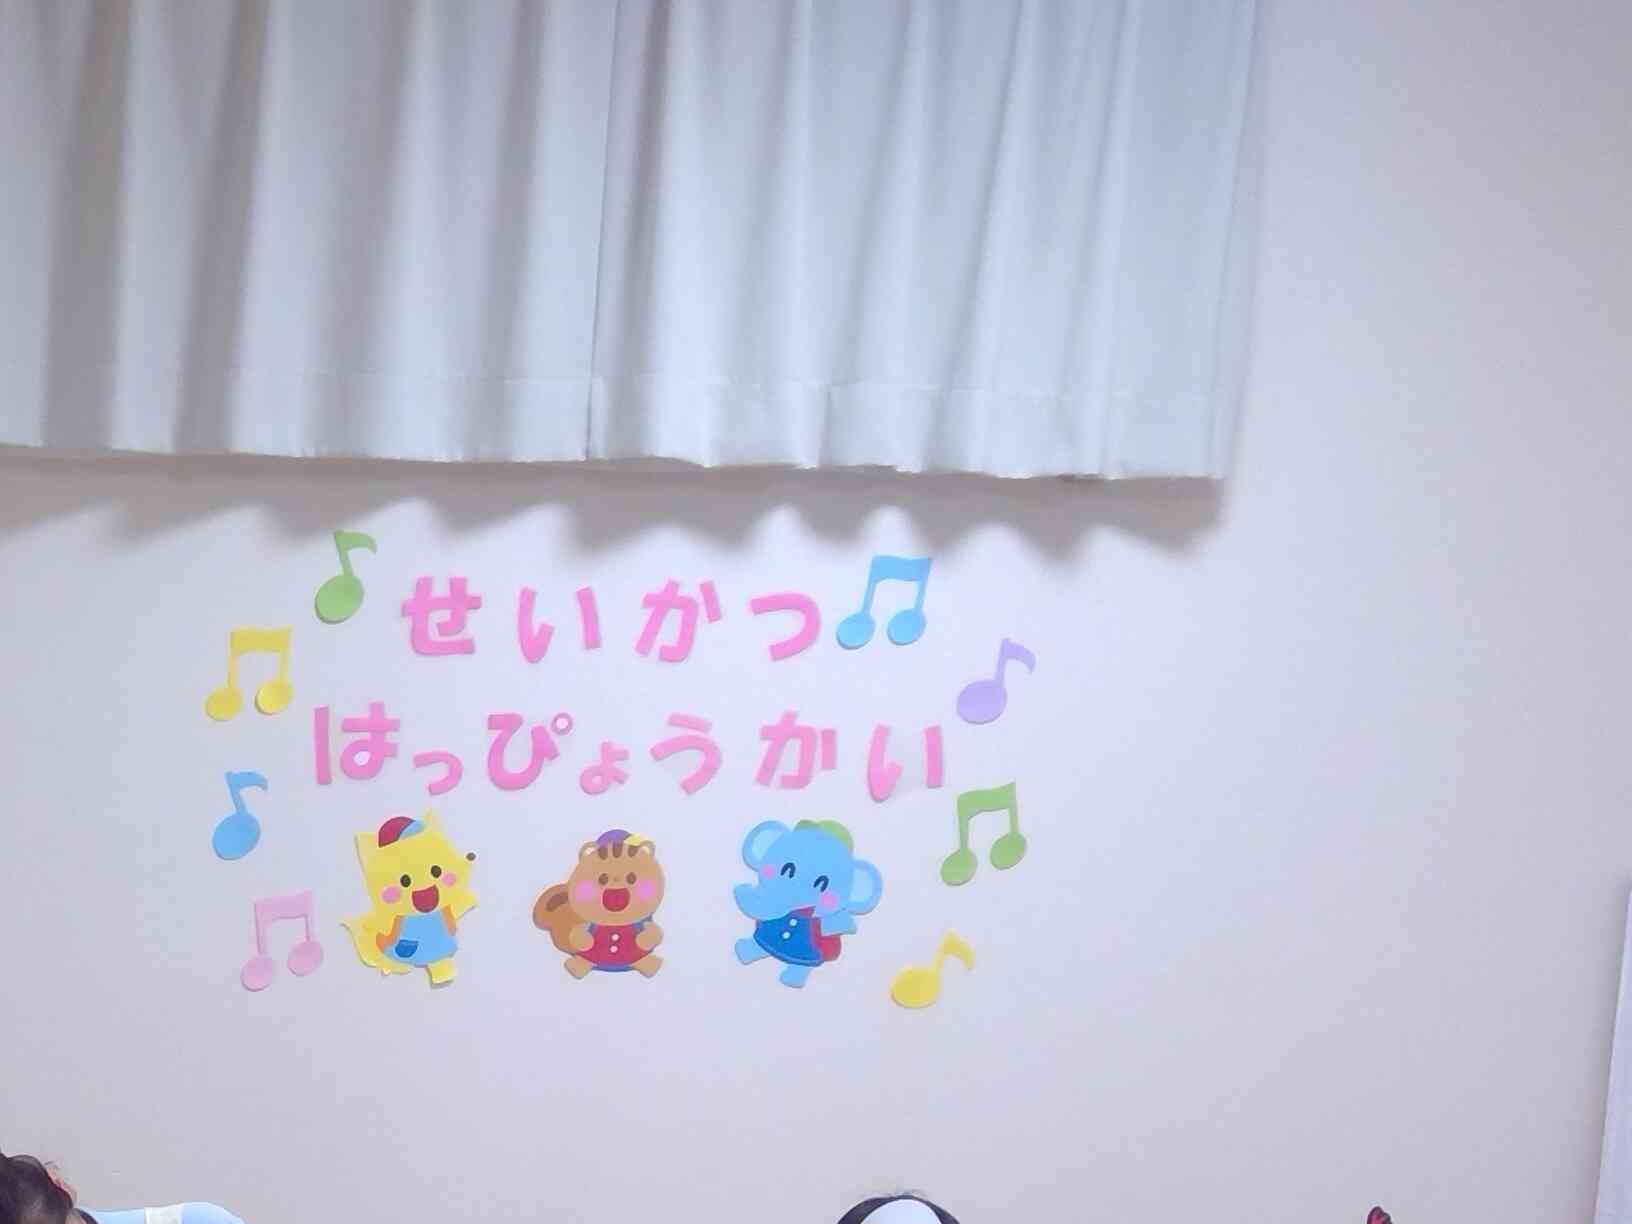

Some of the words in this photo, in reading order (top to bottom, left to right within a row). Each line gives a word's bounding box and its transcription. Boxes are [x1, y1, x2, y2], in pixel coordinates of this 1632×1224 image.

[401, 575, 822, 663] せいかつ
[313, 702, 944, 802] はっぴょうかい
